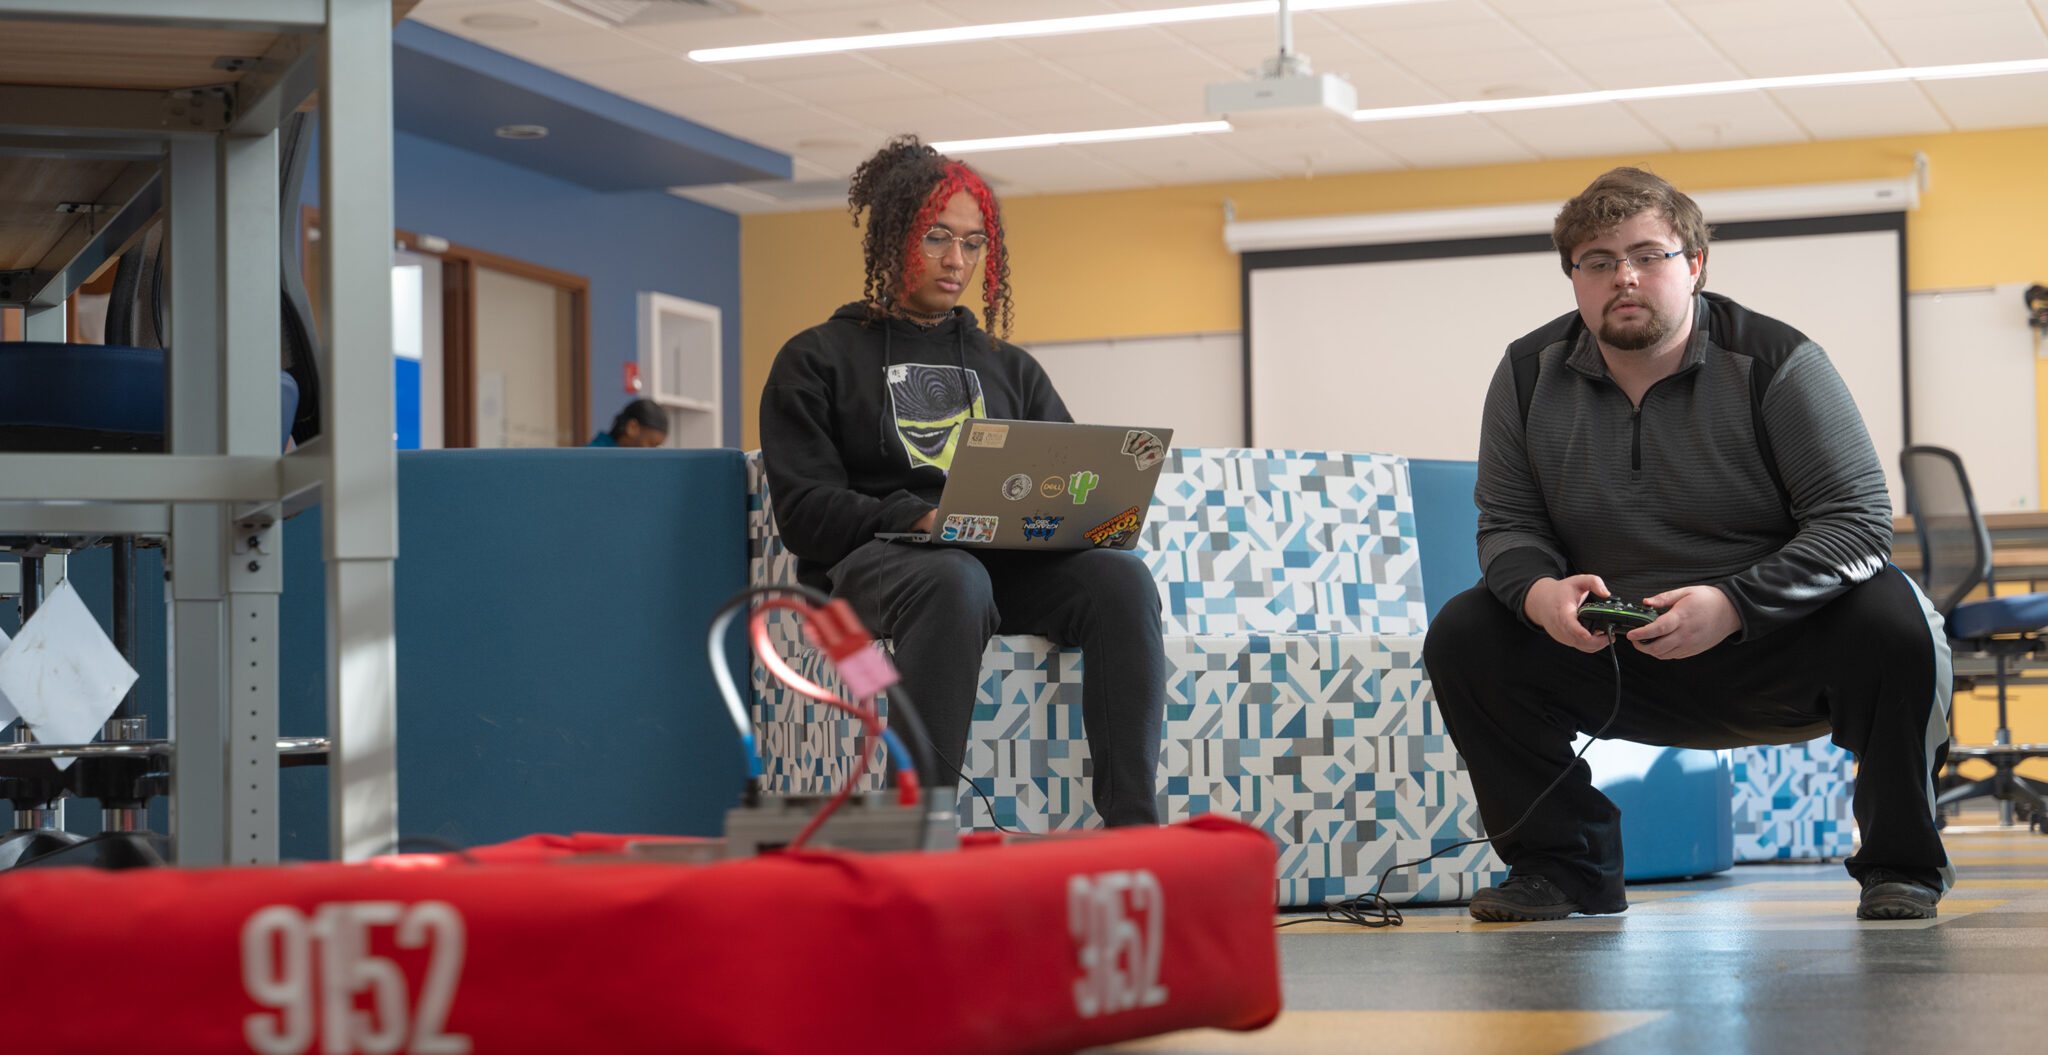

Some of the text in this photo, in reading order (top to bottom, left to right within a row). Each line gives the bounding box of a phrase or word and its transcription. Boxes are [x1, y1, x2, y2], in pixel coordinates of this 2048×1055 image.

[1043, 483, 1062, 491] DELL
[1083, 505, 1139, 538] UNDERGROUND
[1091, 514, 1138, 544] GORGE
[240, 899, 474, 1055] 9152
